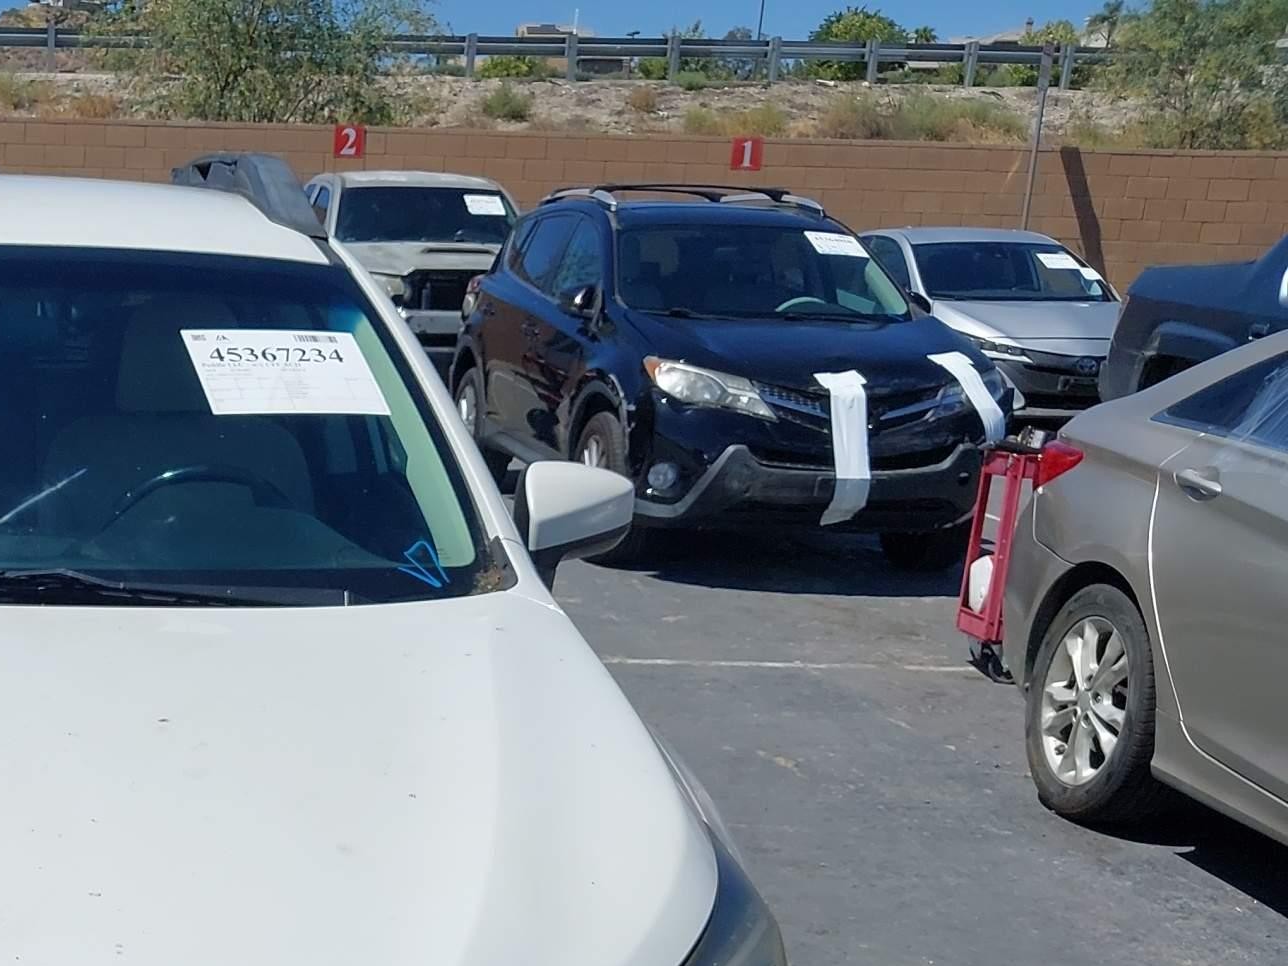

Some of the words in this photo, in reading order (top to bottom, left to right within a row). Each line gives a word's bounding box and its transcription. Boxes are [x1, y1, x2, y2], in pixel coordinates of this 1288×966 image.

[340, 127, 357, 155] 2
[741, 140, 754, 168] 1
[209, 346, 344, 363] 45367234
